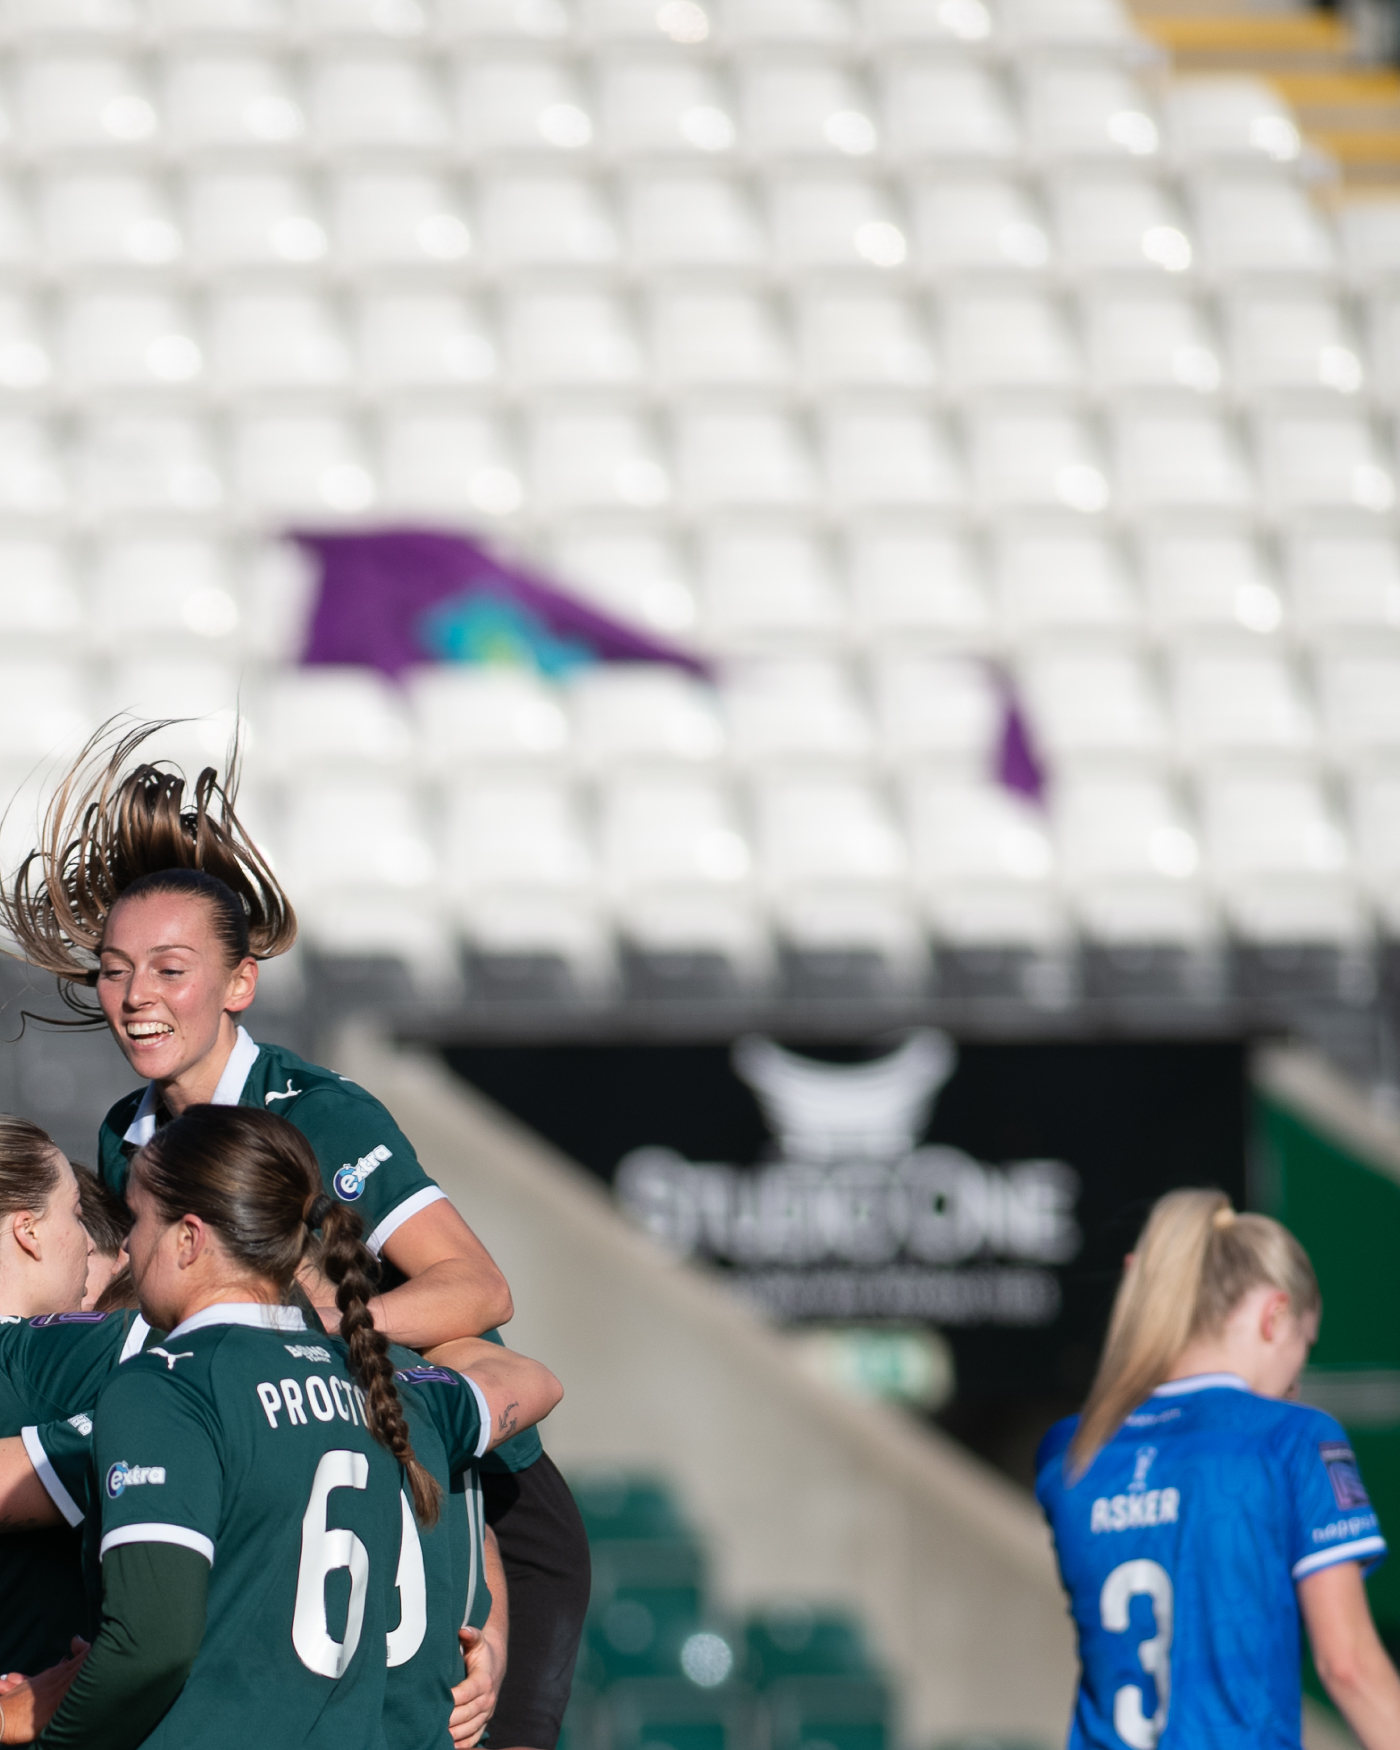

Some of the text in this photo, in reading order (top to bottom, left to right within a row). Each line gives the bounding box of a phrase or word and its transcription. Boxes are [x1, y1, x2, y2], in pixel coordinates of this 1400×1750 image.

[334, 1144, 393, 1201] extra
[106, 1460, 166, 1499] extra
[1091, 1487, 1180, 1534] ASKER
[292, 1449, 370, 1679] 6
